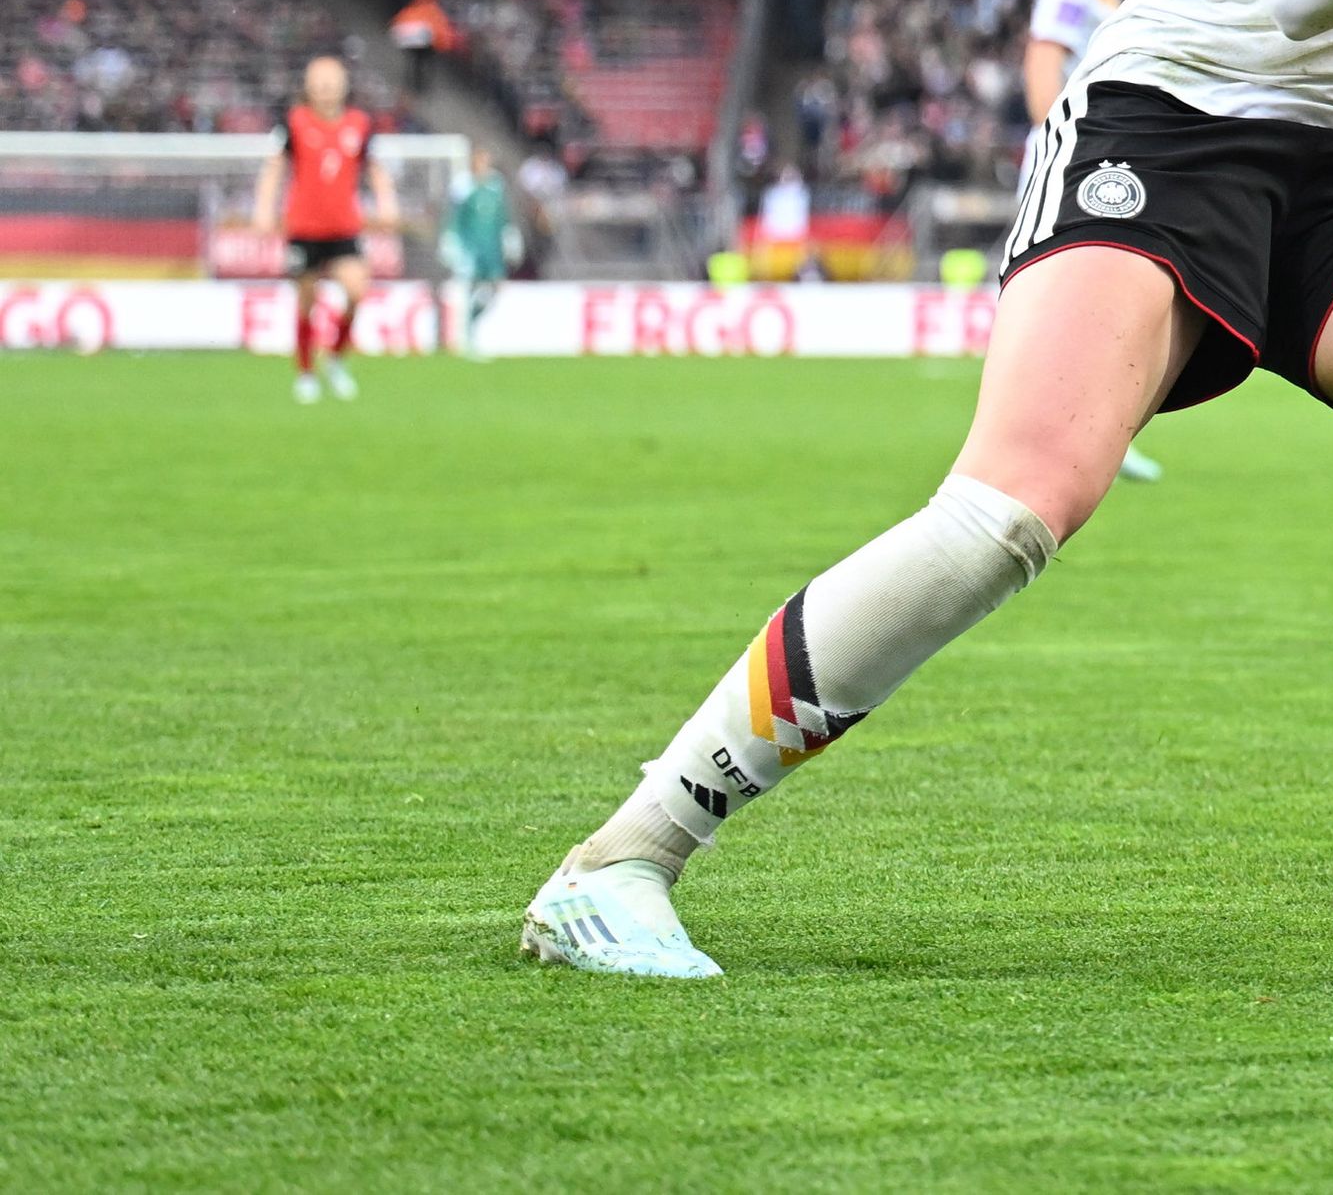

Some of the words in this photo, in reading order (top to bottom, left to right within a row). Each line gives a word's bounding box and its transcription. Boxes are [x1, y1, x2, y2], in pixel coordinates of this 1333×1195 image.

[0, 285, 114, 349] GO
[581, 287, 796, 356] ERGO
[913, 290, 997, 356] ER
[711, 747, 761, 798] DFB
